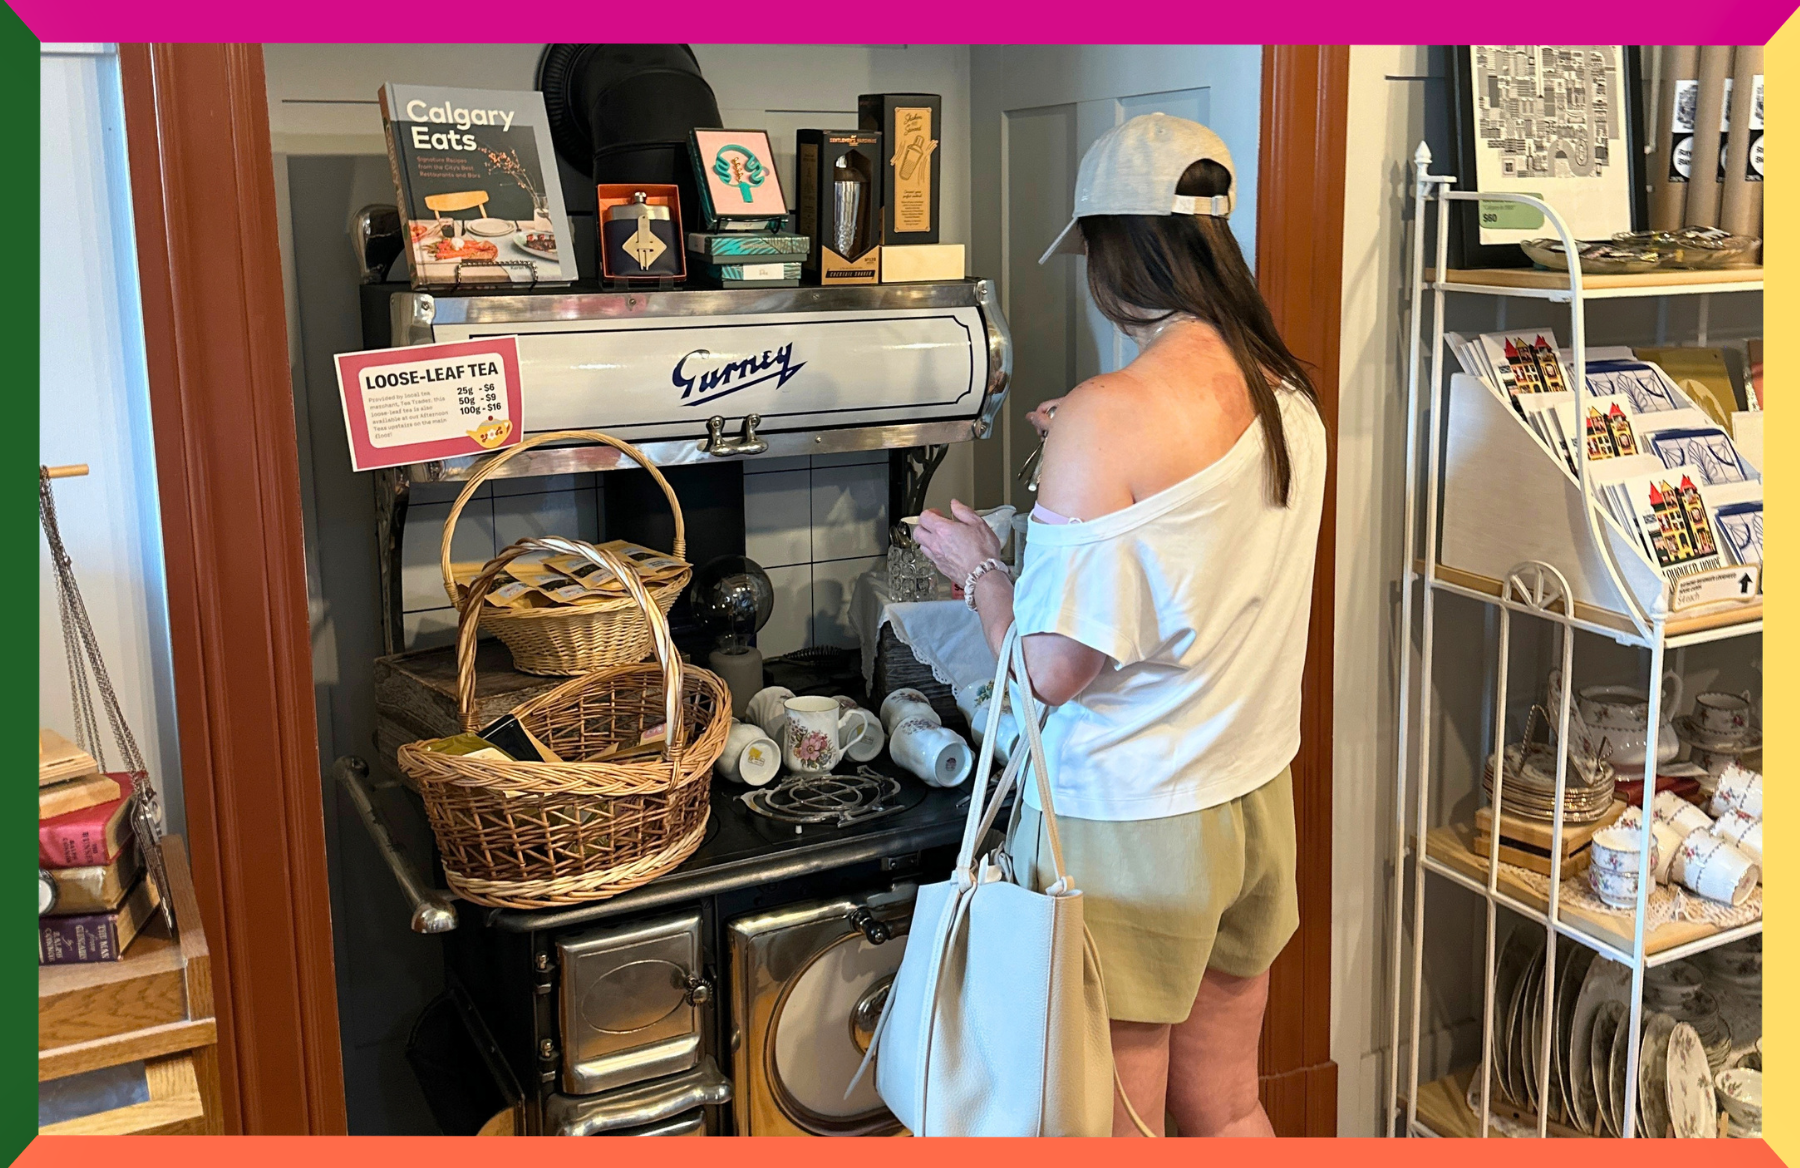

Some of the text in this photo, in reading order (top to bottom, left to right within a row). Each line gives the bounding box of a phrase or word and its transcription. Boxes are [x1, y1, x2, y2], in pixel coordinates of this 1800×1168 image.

[406, 100, 514, 132] Calgary
[411, 126, 477, 151] Eats
[365, 361, 499, 390] LOOSE-LEAF TEA
[672, 342, 800, 400] Gurney
[457, 386, 474, 396] 25g
[484, 383, 495, 392] $6
[368, 395, 395, 403] Provided
[459, 396, 475, 405] 50g
[486, 393, 496, 402] $9
[371, 409, 401, 418] loose-leaf
[460, 405, 481, 415] 100g
[487, 402, 502, 411] $16
[372, 416, 401, 424] available
[420, 410, 449, 418] Afternoon
[388, 422, 413, 431] upstairs
[98, 924, 109, 959] THE MAN
